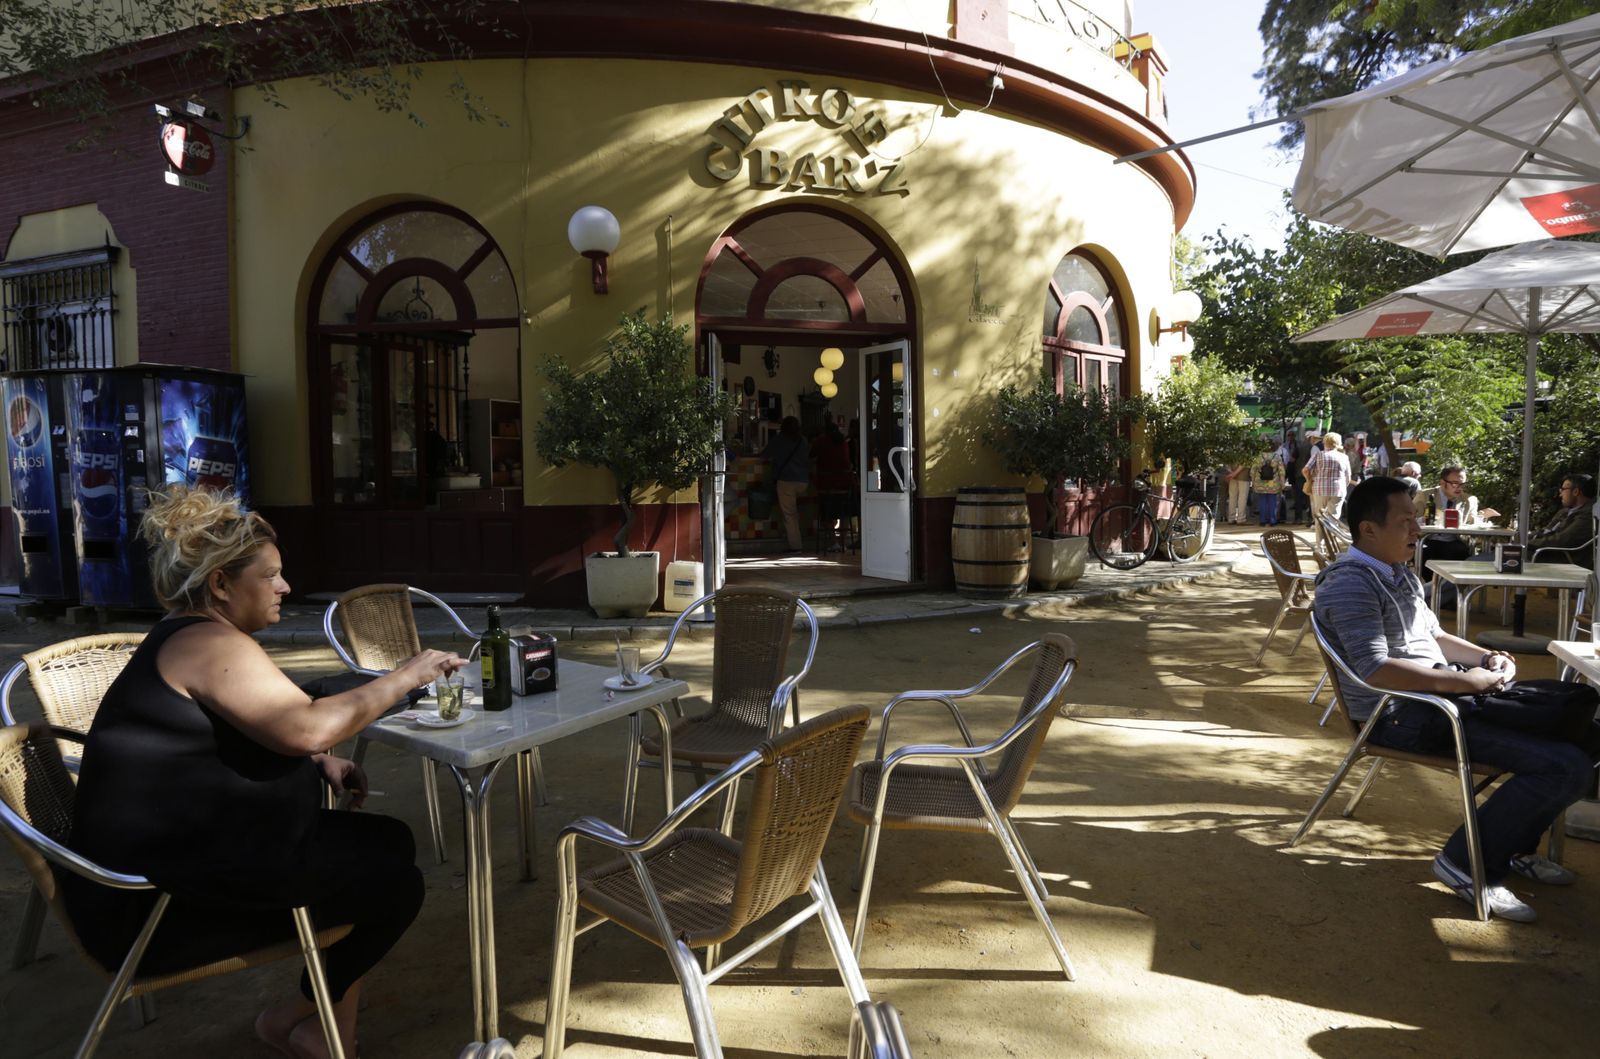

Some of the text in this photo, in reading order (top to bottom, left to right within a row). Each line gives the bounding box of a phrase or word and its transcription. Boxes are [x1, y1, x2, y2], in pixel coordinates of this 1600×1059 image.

[755, 149, 866, 193] BAR
[73, 452, 119, 470] EPSI
[188, 456, 237, 477] PEPSI
